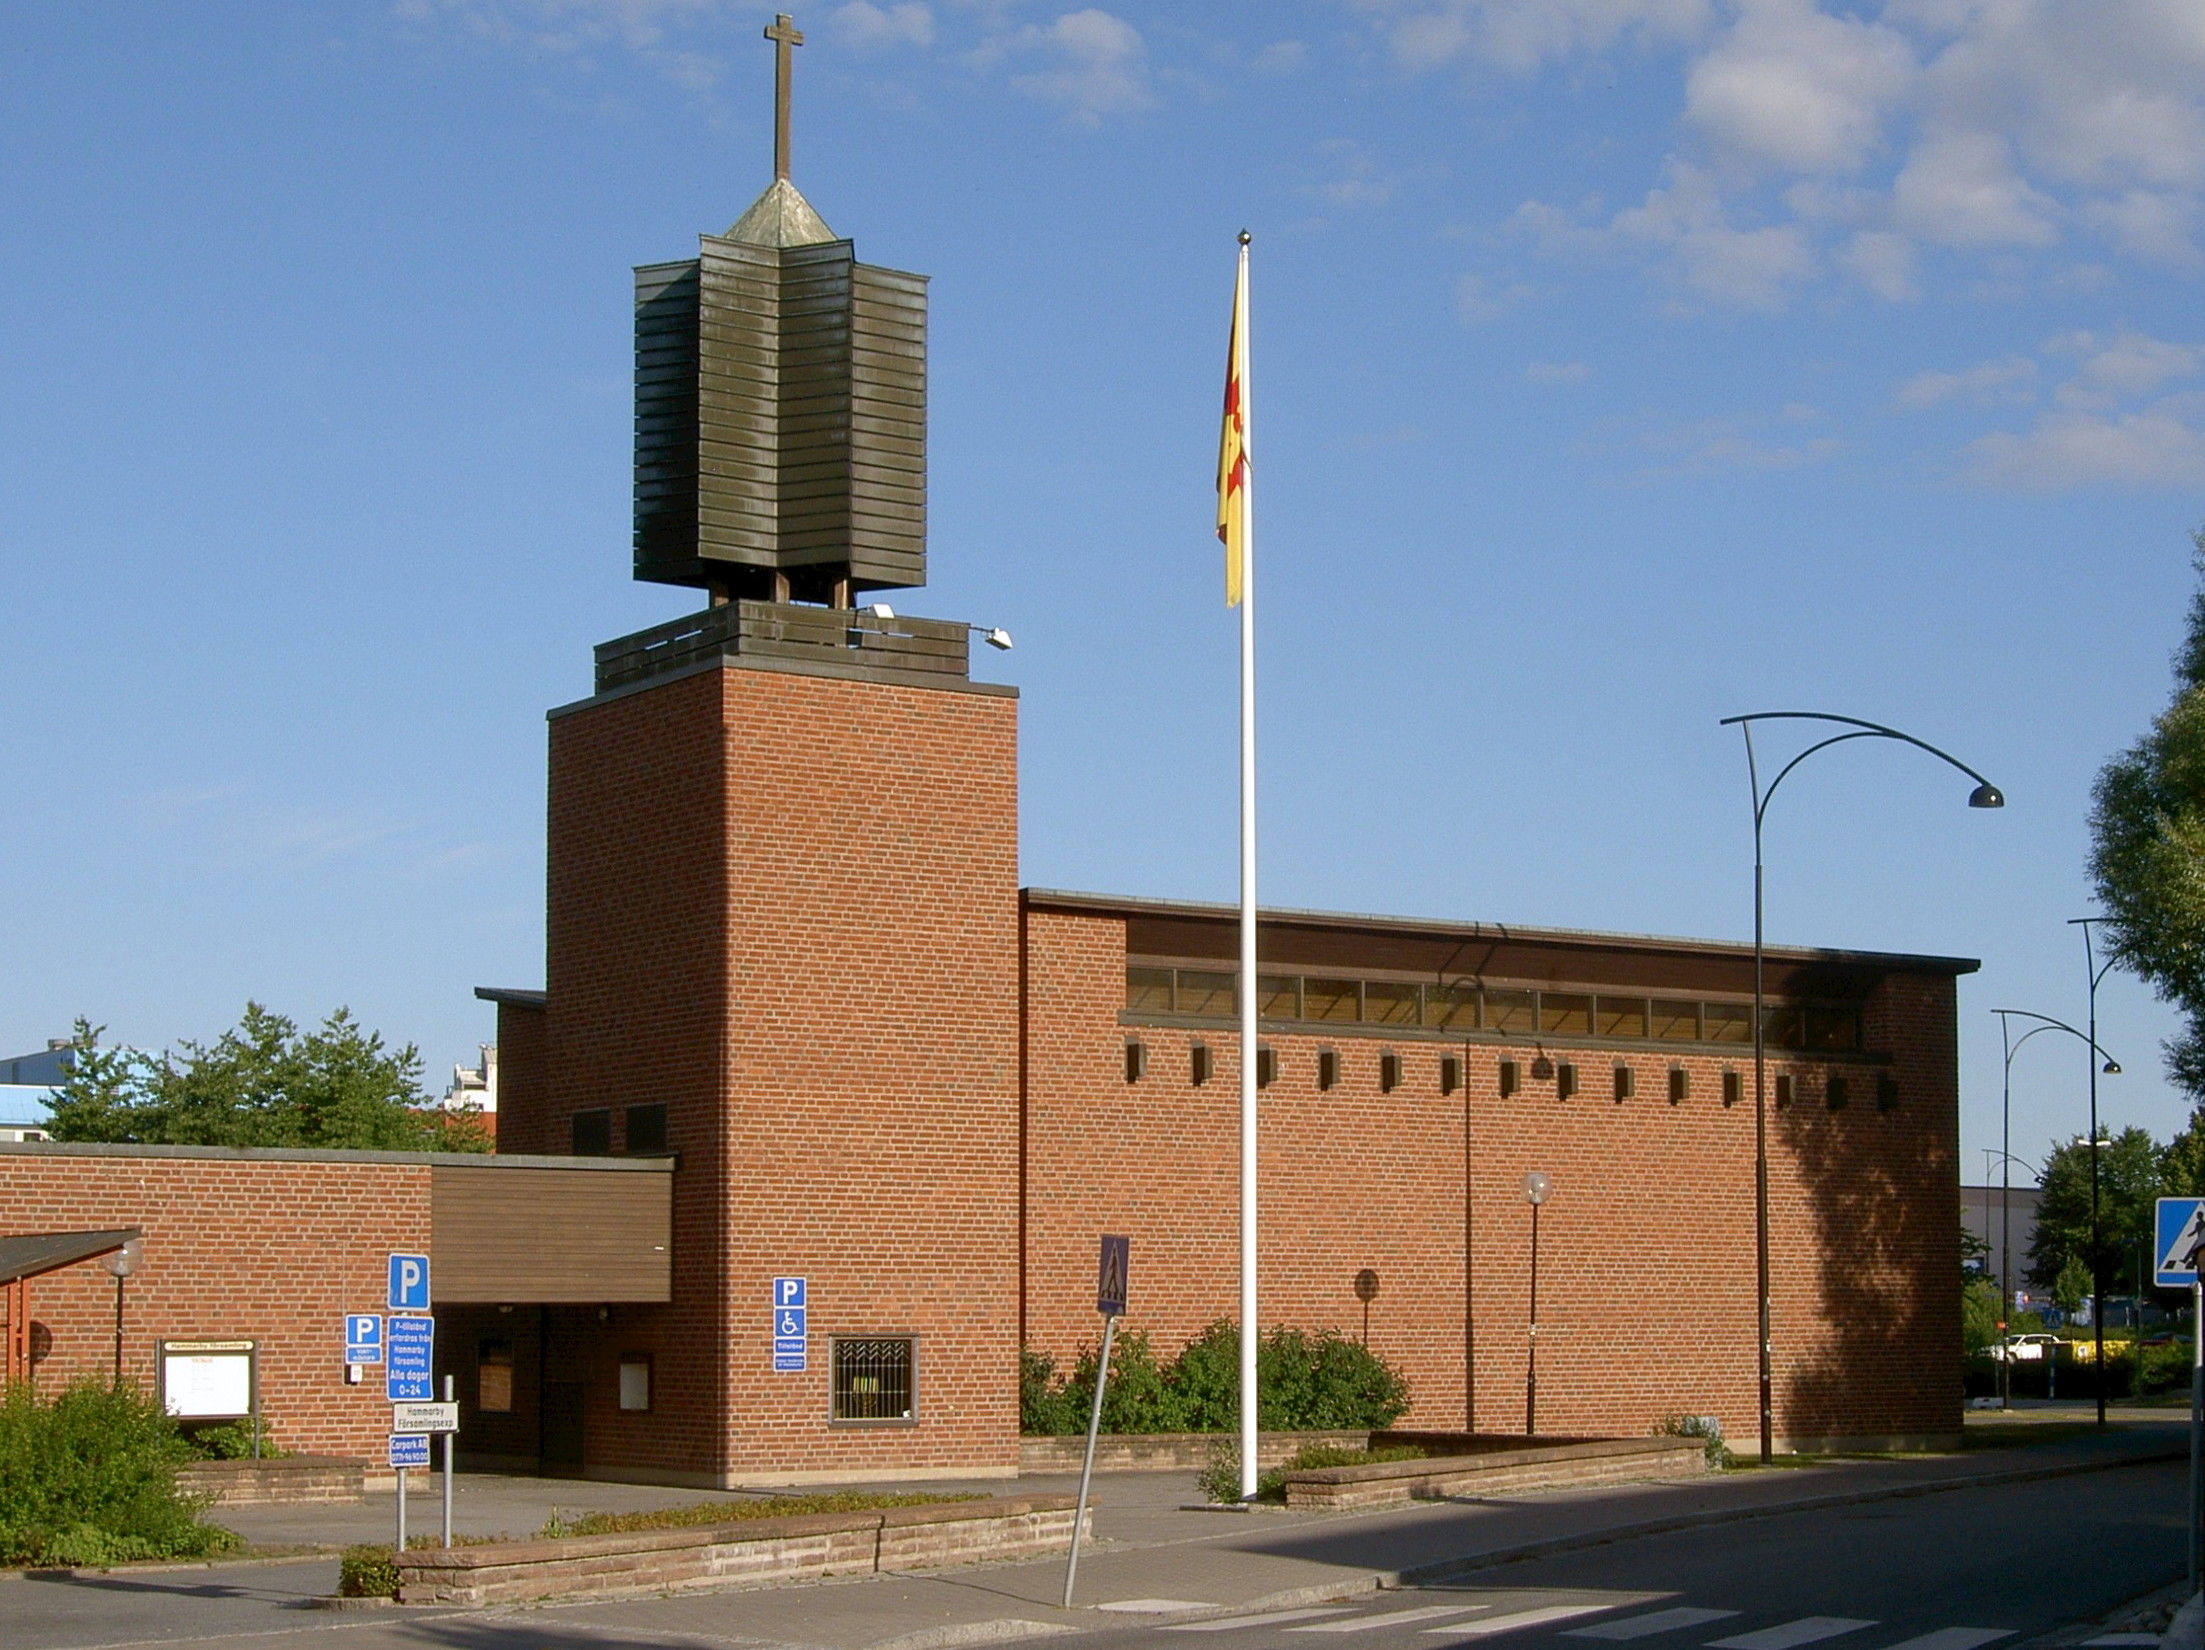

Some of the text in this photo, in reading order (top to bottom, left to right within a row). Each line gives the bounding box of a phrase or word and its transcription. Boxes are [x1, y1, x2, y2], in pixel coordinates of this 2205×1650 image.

[401, 1260, 421, 1304] P
[783, 1280, 798, 1305] P
[356, 1318, 374, 1343] P
[394, 1346, 426, 1356] Hammarby
[394, 1357, 426, 1368] församling
[390, 1369, 430, 1382] Alla dagar
[399, 1384, 421, 1395] 0-24
[407, 1407, 445, 1417] Hammarby
[398, 1418, 454, 1429] Församlingsexp
[392, 1438, 428, 1451] Carpark AB
